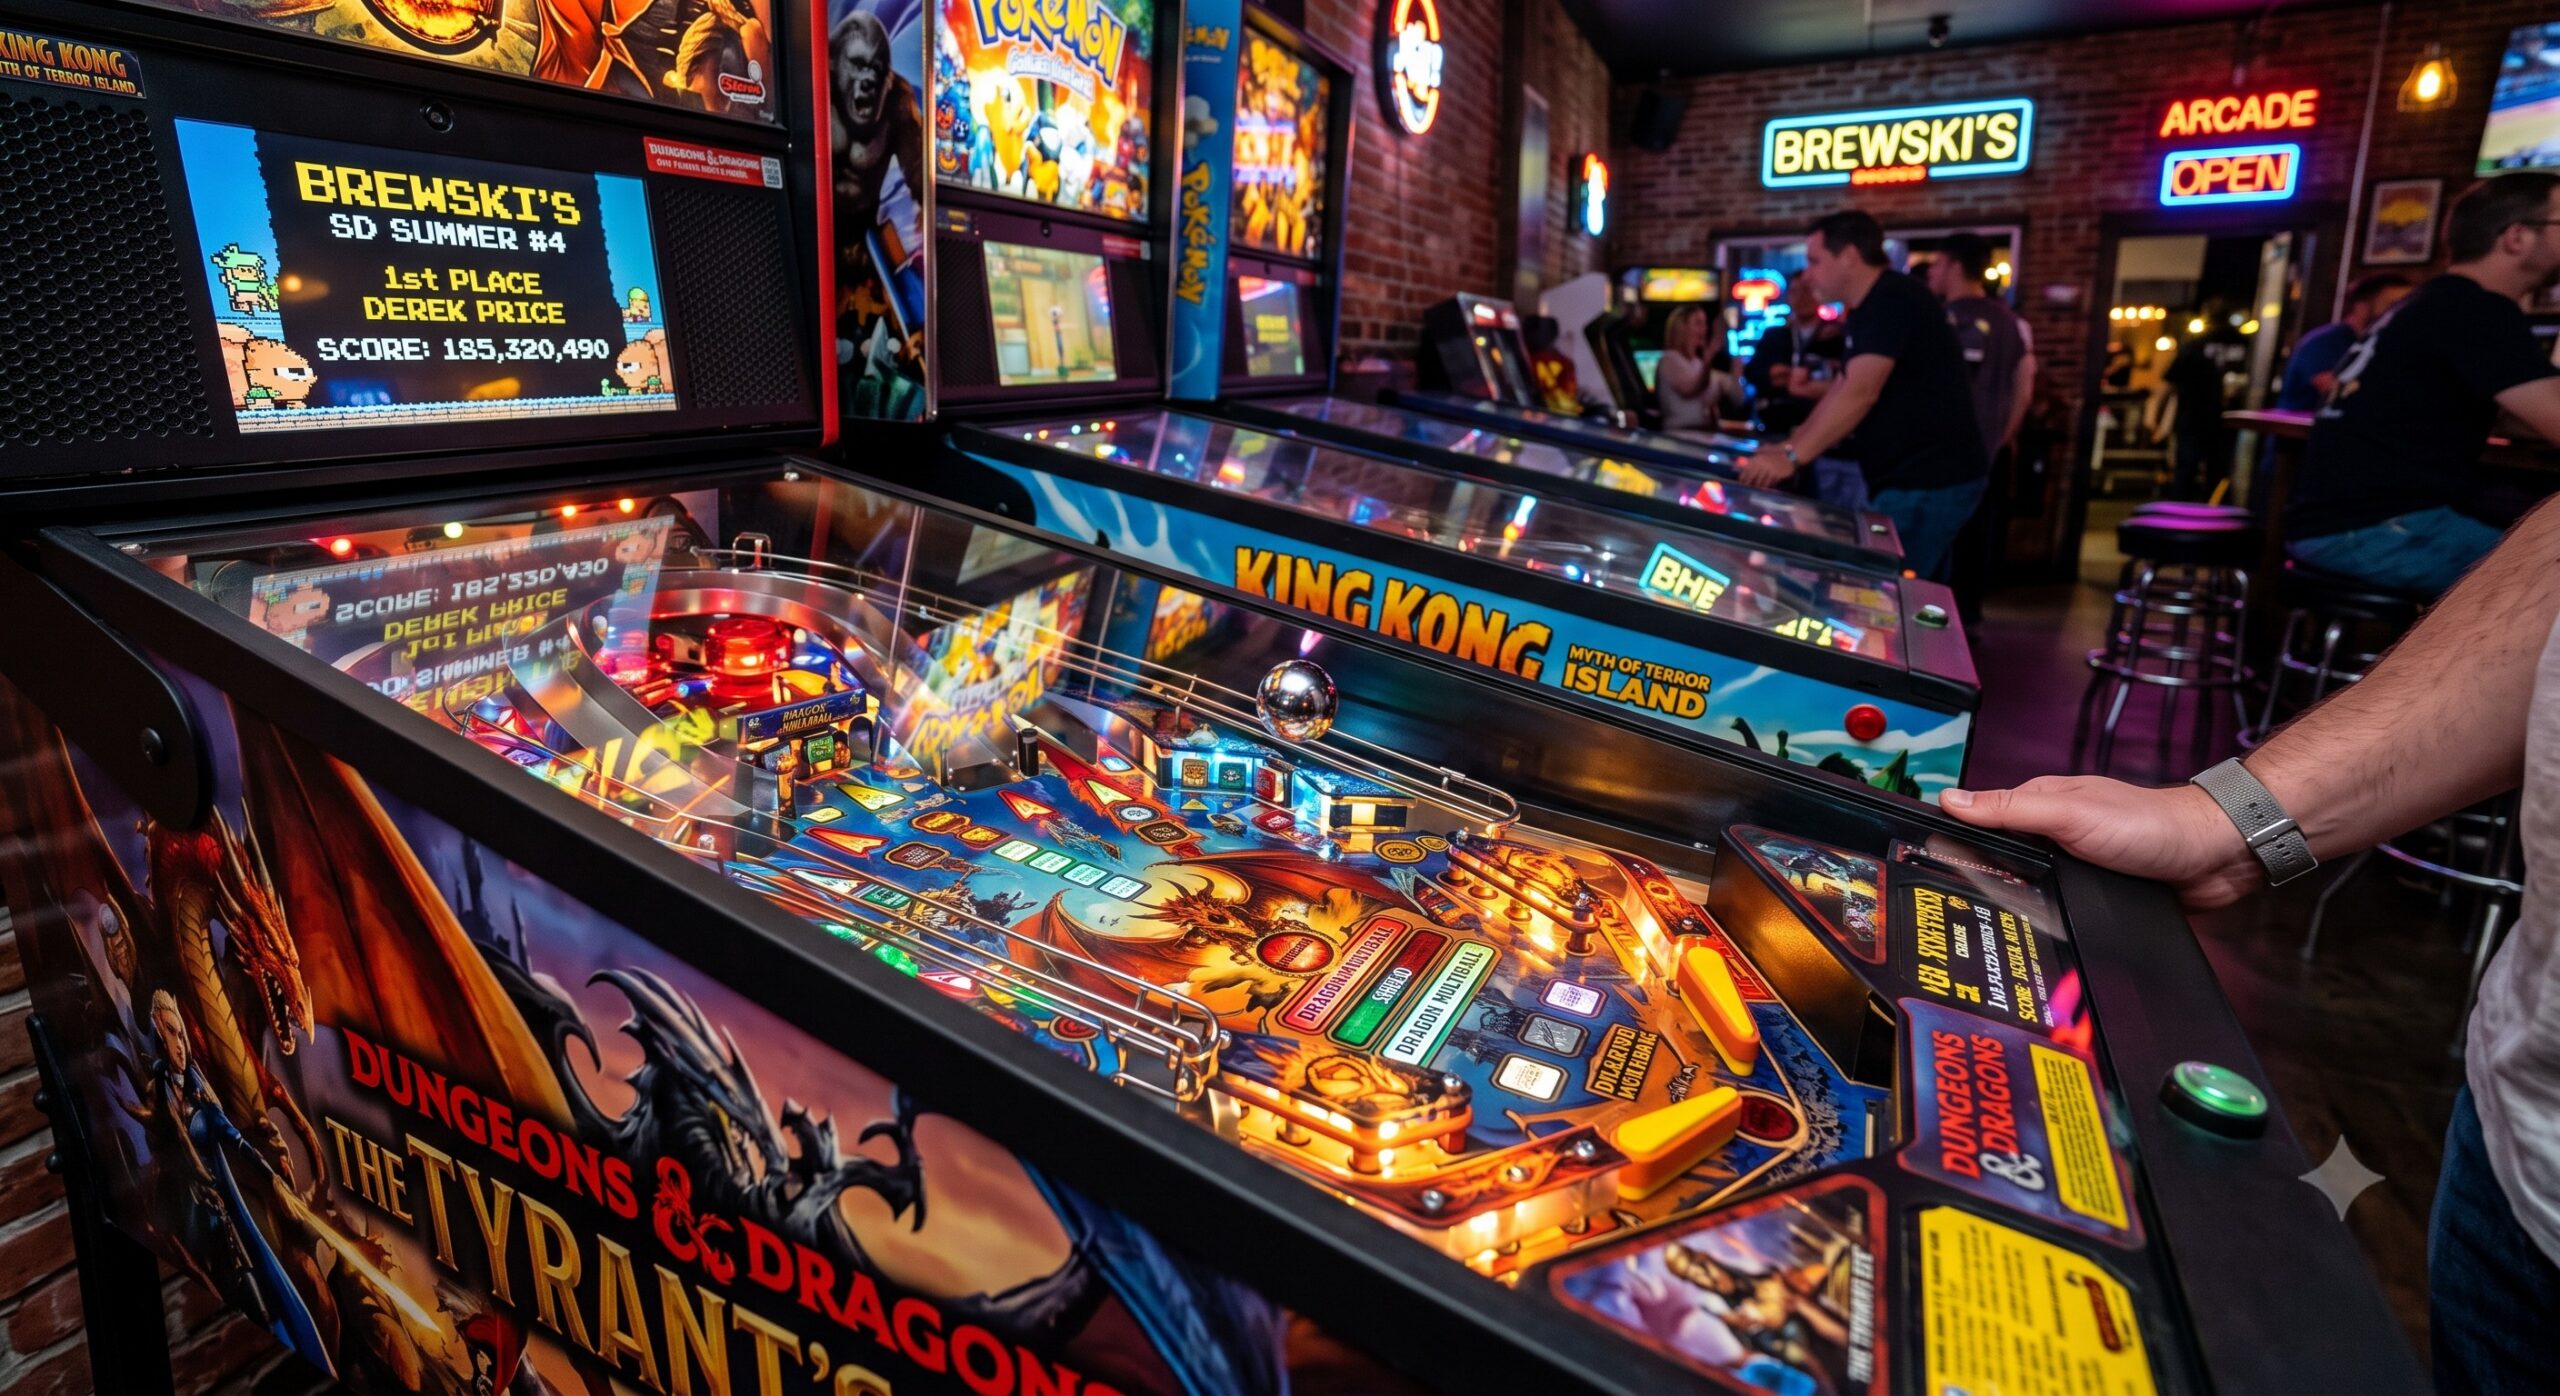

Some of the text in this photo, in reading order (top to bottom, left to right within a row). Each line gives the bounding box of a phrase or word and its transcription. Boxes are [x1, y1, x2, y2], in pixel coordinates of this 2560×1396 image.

[0, 61, 136, 94] TH OF TERROR ISLAND
[58, 41, 127, 78] KONG
[2159, 88, 2320, 138] ARCADE
[1773, 112, 2018, 174] BREWSKI'S
[294, 161, 582, 226] BREWSKI'S
[2171, 152, 2290, 197] OPEN
[329, 212, 567, 253] SD SUMMER #4
[385, 265, 543, 295] 1st PLACE
[363, 296, 567, 325] DEREK PRICE
[317, 337, 611, 363] SCORE: 185,320,490
[1235, 546, 1553, 683] KING KONG
[1561, 660, 1709, 720] ISLAND
[1568, 643, 1712, 692] MYTH OF TERROR
[1395, 950, 1484, 1056] DRAGON MULTIBALL
[1931, 1030, 1982, 1180] DUNGEONS
[1969, 1033, 2020, 1156] DRAGONS
[325, 1115, 414, 1226] THE
[1978, 1151, 2046, 1192] &
[341, 1028, 1132, 1396] DUNGEONS & DRAGON
